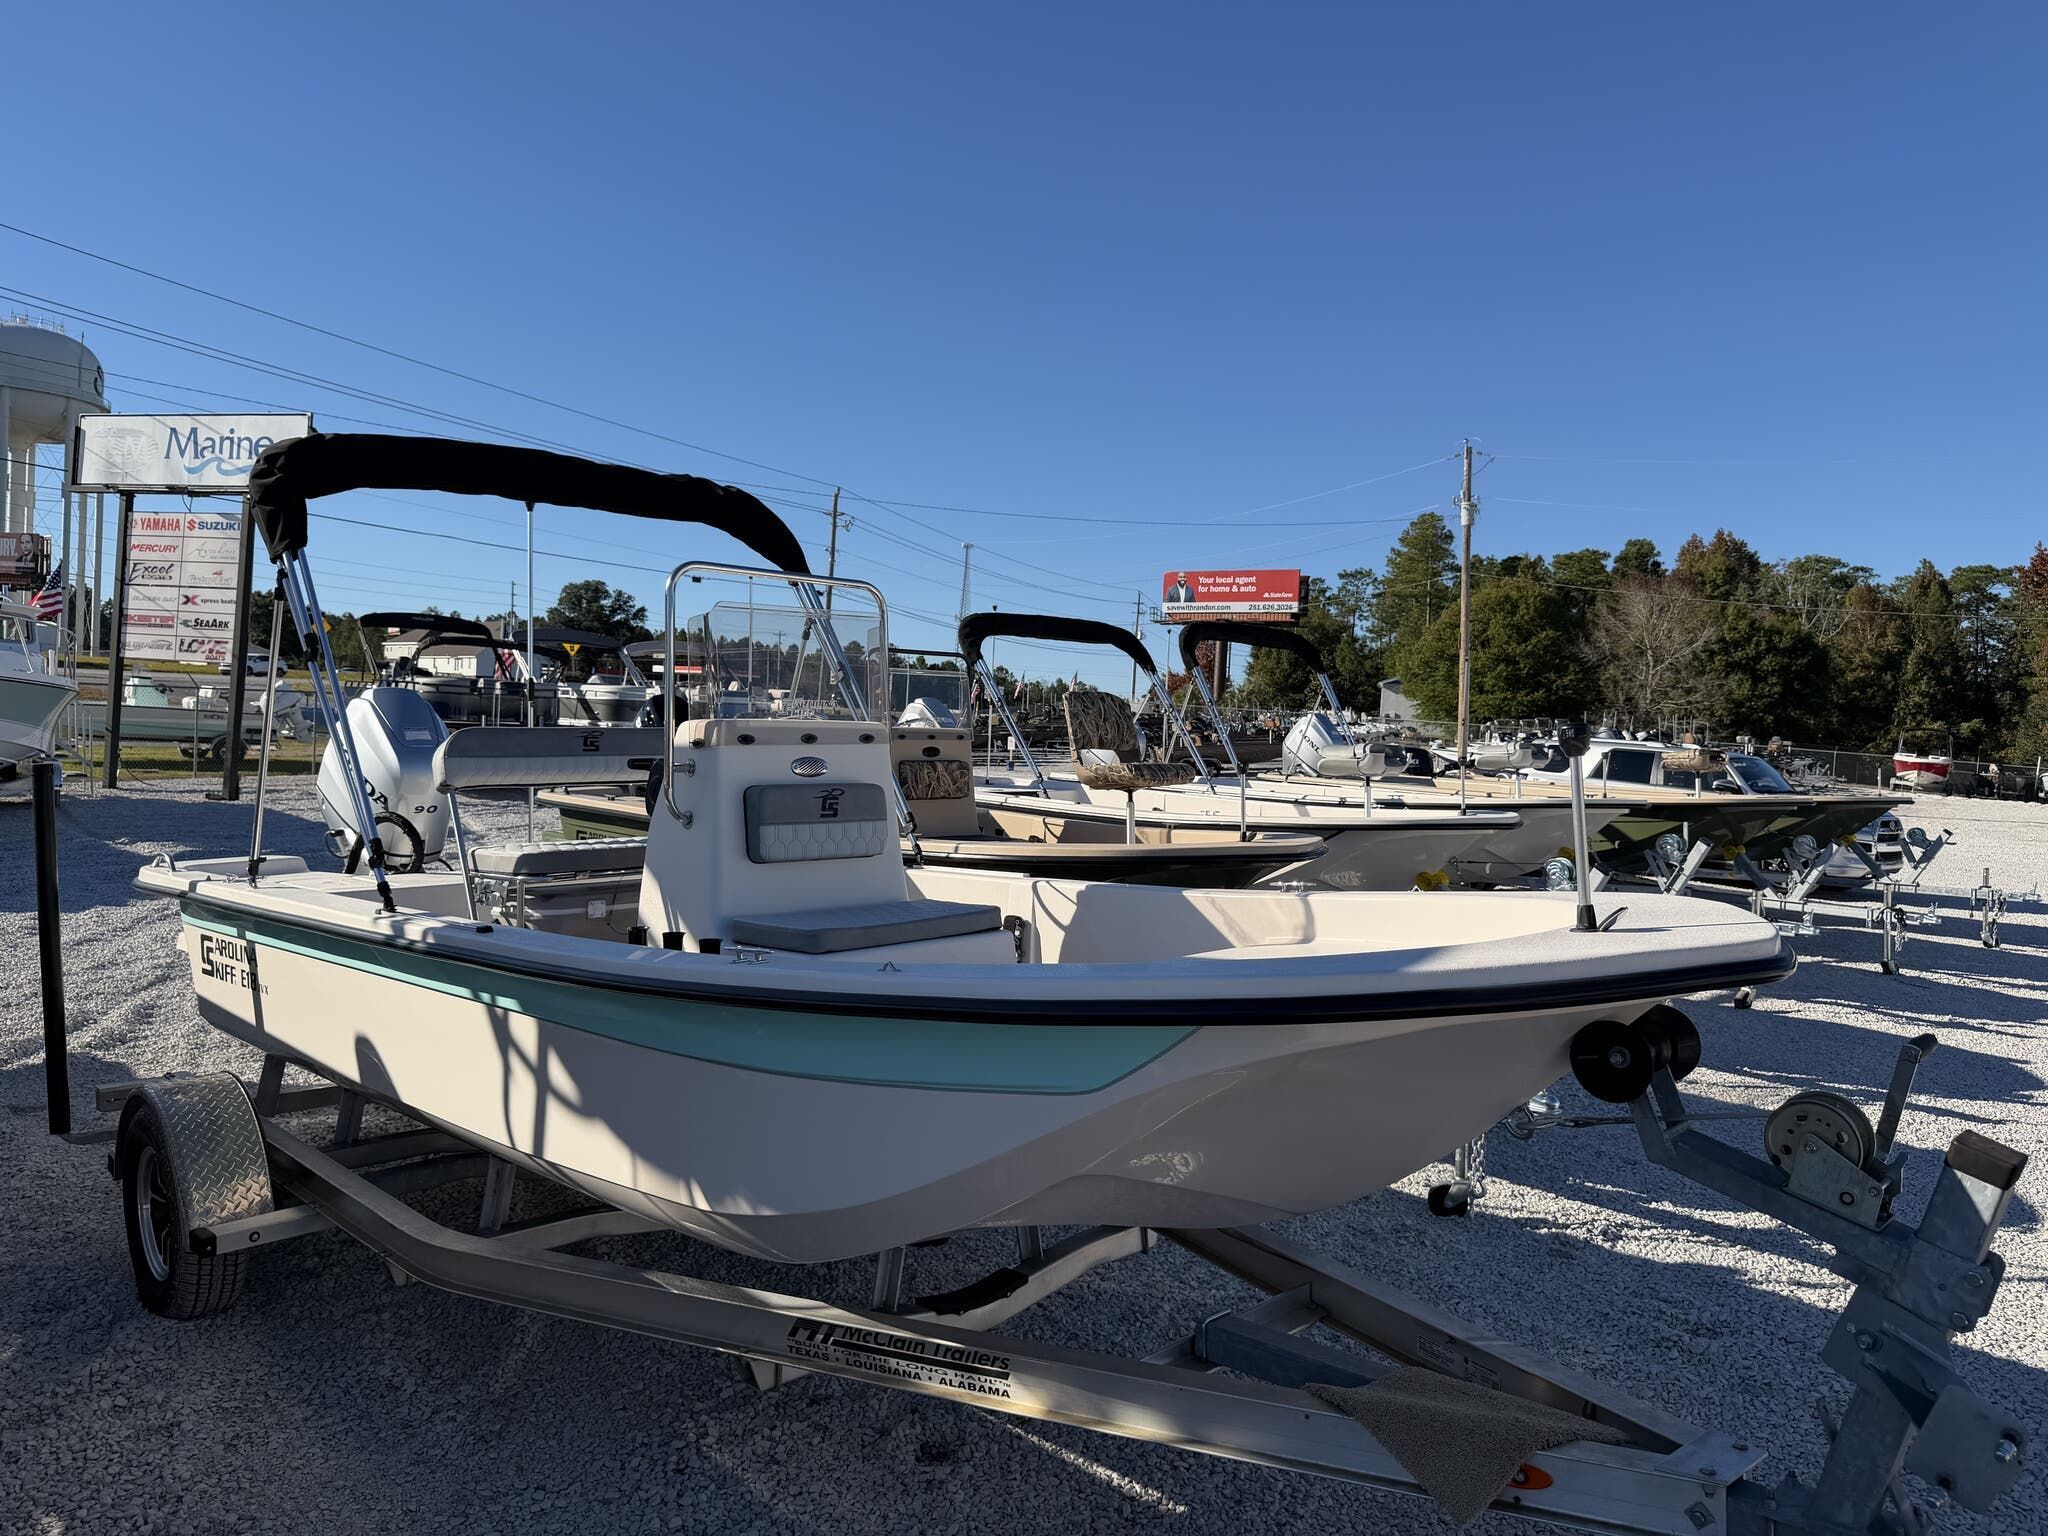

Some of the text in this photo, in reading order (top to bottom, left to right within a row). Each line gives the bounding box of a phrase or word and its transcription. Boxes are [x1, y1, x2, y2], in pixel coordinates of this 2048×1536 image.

[164, 426, 274, 460] Marine
[140, 518, 181, 532] YAMAHA
[197, 520, 241, 531] SUZUKI
[129, 543, 180, 553] MERCURY
[1198, 575, 1257, 585] Your local agent
[1198, 585, 1257, 593] for home & auto
[413, 805, 438, 814] 90
[842, 1326, 926, 1354] McClain
[933, 1343, 1011, 1370] Trailers
[787, 1344, 1011, 1398] TEXAS LOUISIANA ALABAMA
[895, 1360, 949, 1376] LONG
